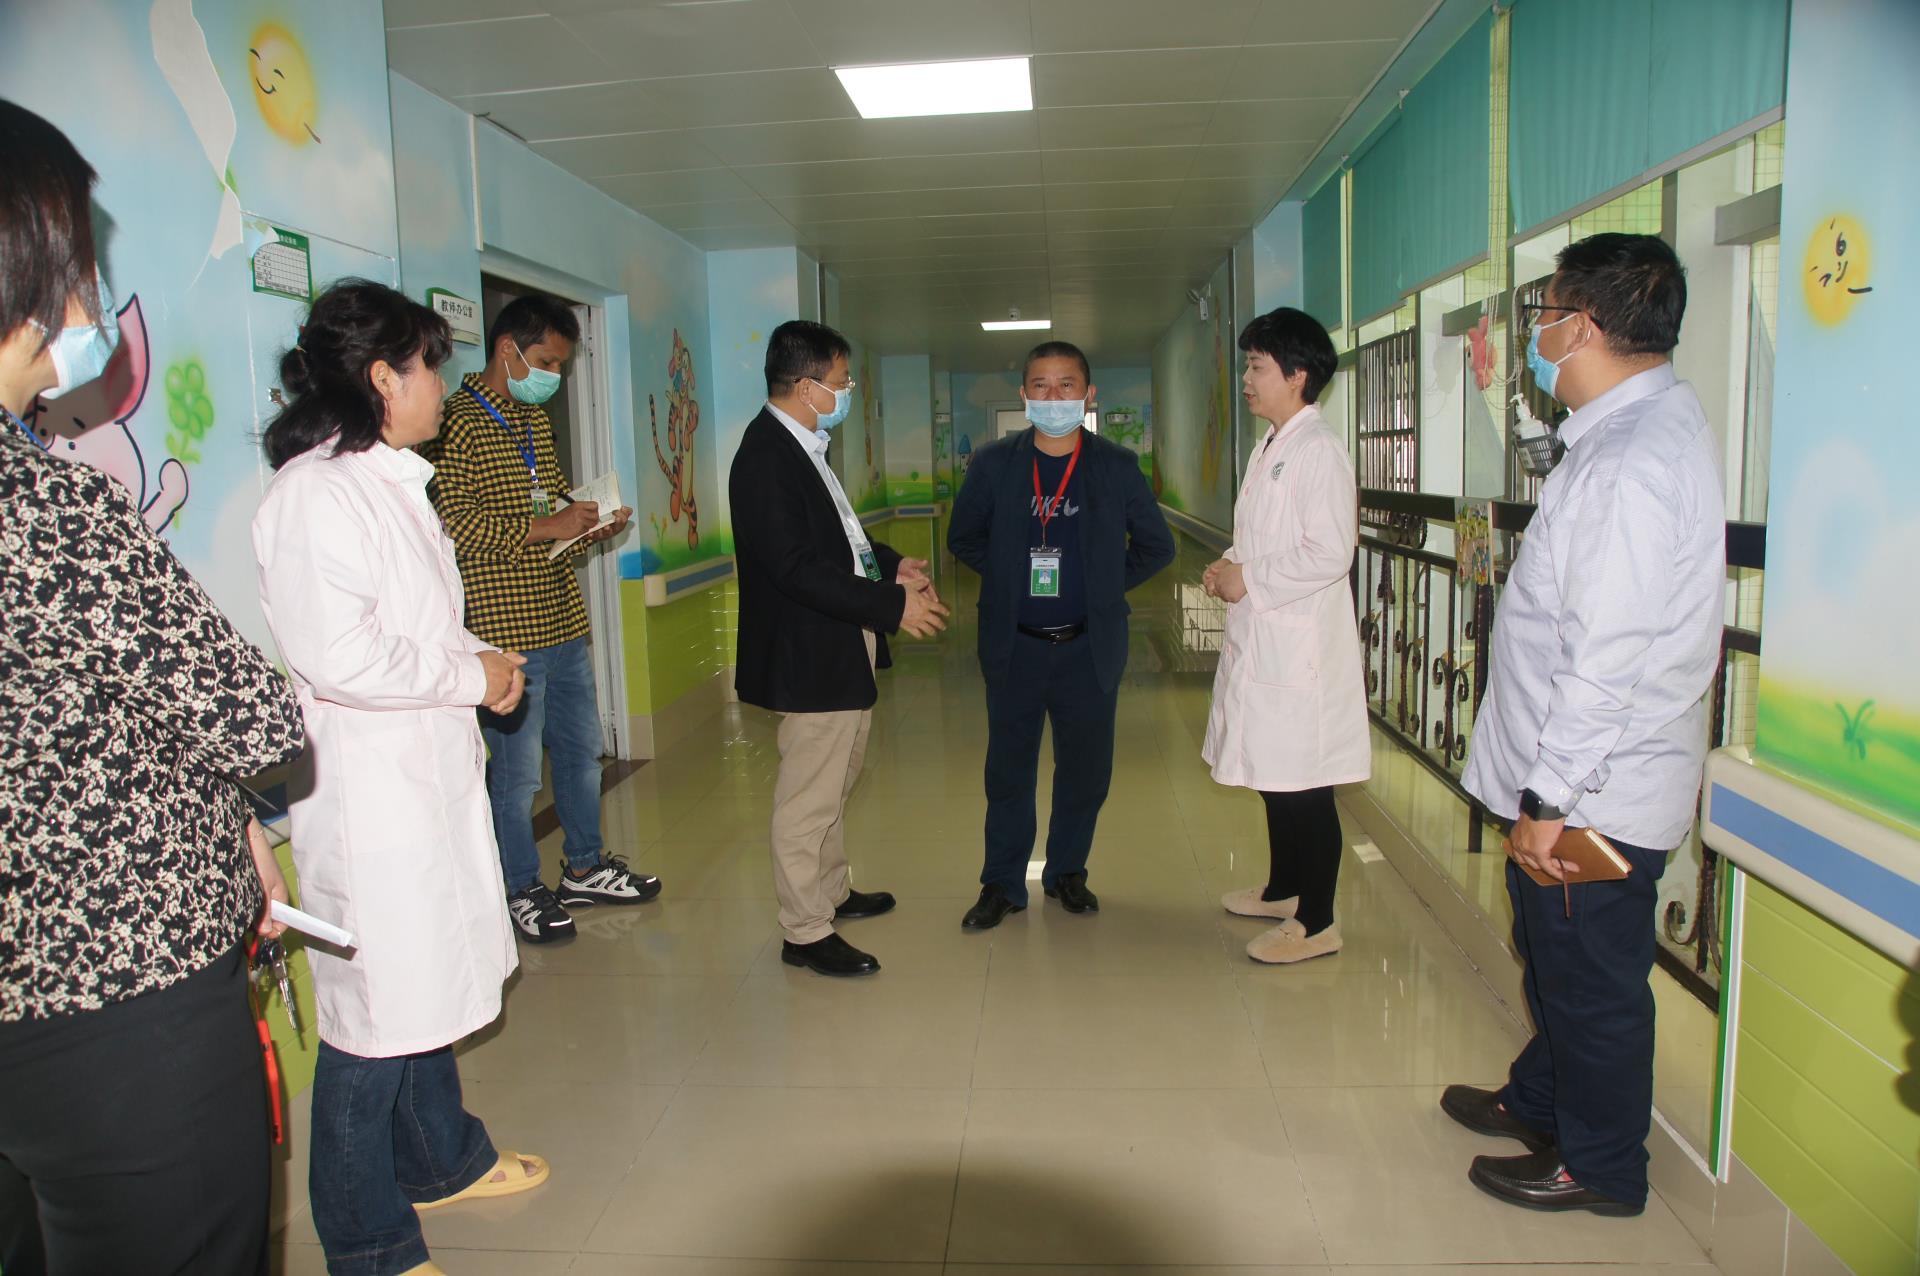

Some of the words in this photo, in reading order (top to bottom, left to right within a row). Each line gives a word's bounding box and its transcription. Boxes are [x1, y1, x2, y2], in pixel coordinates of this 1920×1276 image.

[441, 298, 473, 319] 教师办公室
